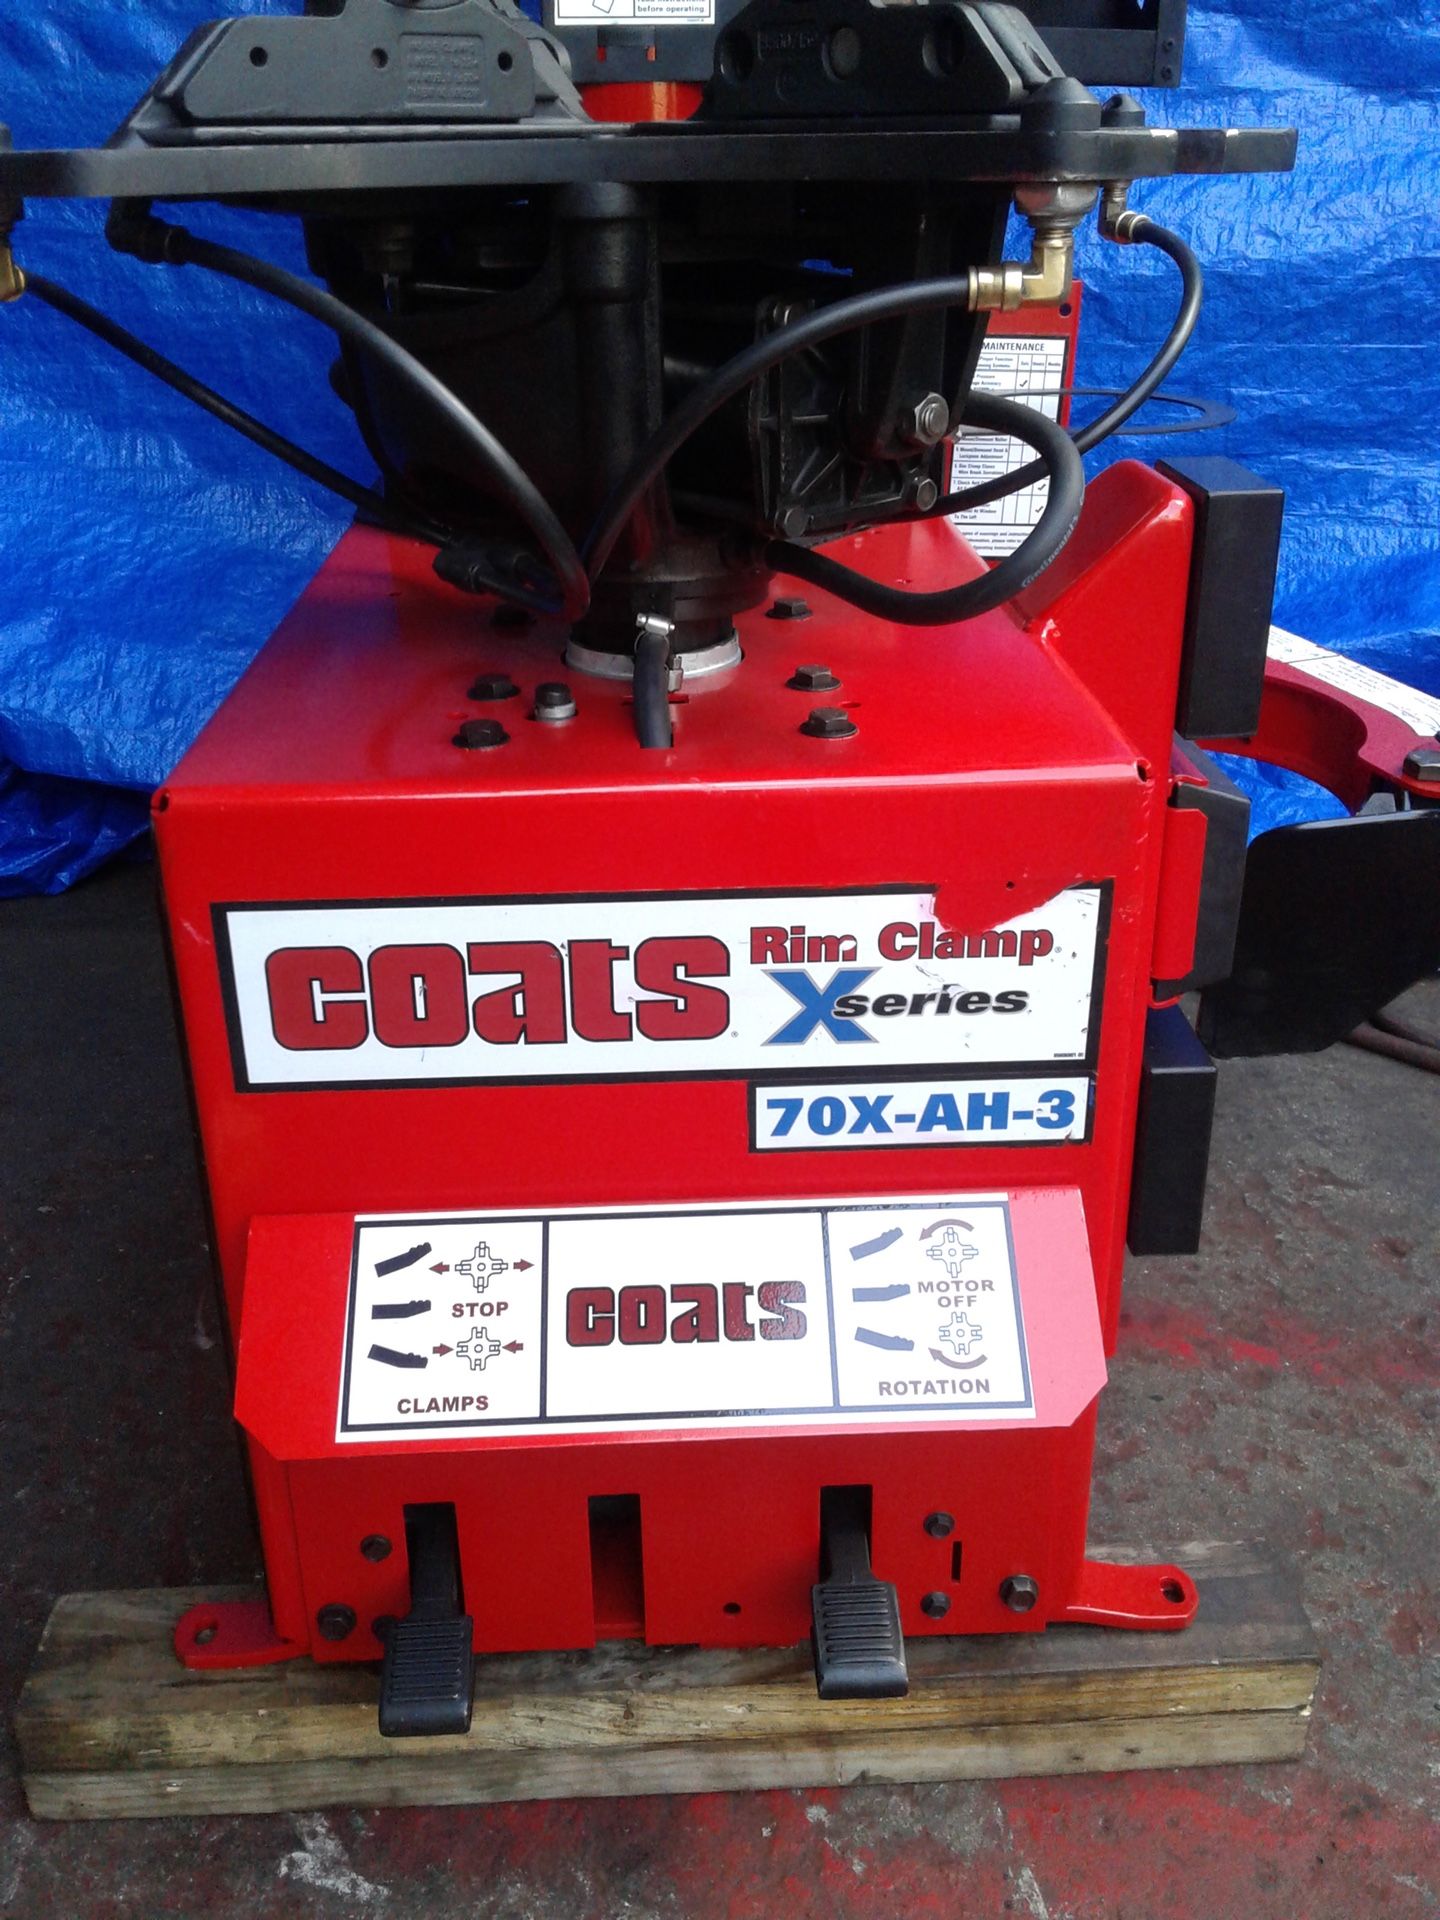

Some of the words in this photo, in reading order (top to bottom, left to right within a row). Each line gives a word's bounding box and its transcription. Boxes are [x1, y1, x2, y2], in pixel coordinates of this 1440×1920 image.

[666, 5, 705, 13] operating
[981, 342, 1045, 351] MAINTENANCE
[749, 925, 857, 964] Rim
[877, 922, 1054, 966] Clamp
[832, 983, 1029, 1019] series
[765, 1089, 1076, 1137] 70X-AH-3
[917, 1279, 995, 1294] MOTOR
[451, 1302, 509, 1318] STOP
[937, 1295, 977, 1308] OFF
[878, 1378, 991, 1396] ROTATION
[397, 1395, 489, 1414] CLAMPS
